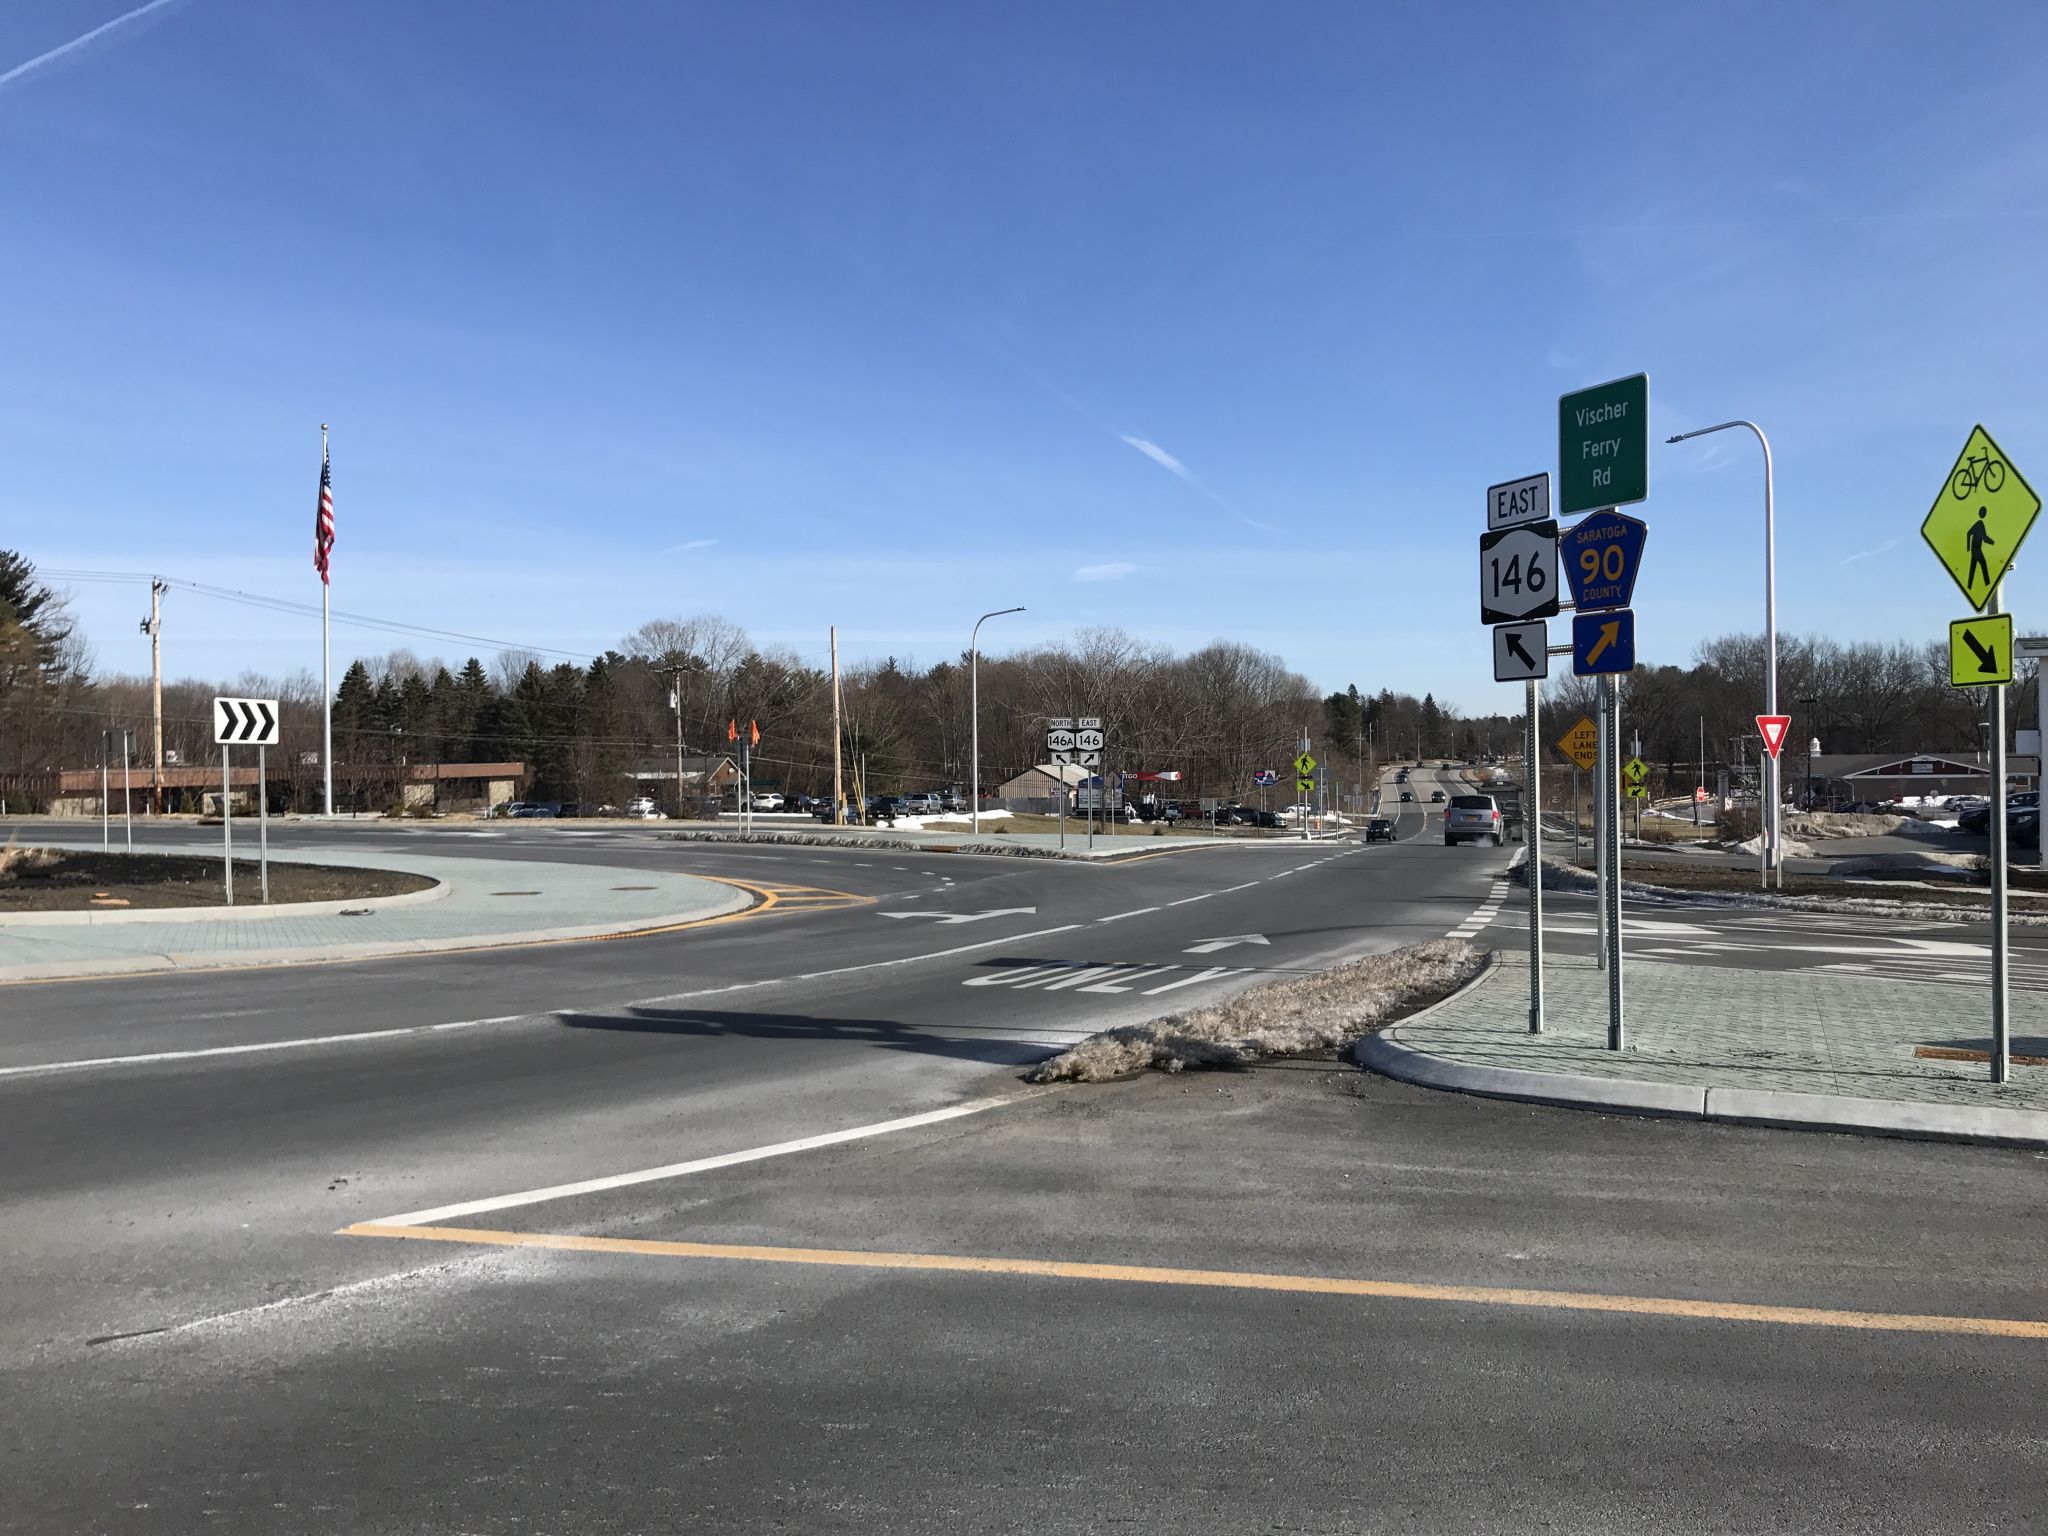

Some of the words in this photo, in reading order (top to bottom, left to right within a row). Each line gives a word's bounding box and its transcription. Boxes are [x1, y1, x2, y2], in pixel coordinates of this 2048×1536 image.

[1575, 401, 1629, 427] Vischer
[1582, 437, 1621, 460] Ferry
[1592, 467, 1611, 488] Rd
[1498, 486, 1538, 519] EAST
[1576, 525, 1628, 544] SARATOGA
[1579, 544, 1625, 585] 90
[1491, 551, 1546, 598] 146
[1583, 585, 1622, 602] COUNTY
[1081, 719, 1098, 727] EAST
[1048, 735, 1074, 747] 146A
[1079, 734, 1100, 746] 146
[1574, 730, 1597, 739] LEFT
[1573, 741, 1598, 750] LANE
[1574, 751, 1598, 760] ENDS
[961, 961, 1257, 996] ONLY
